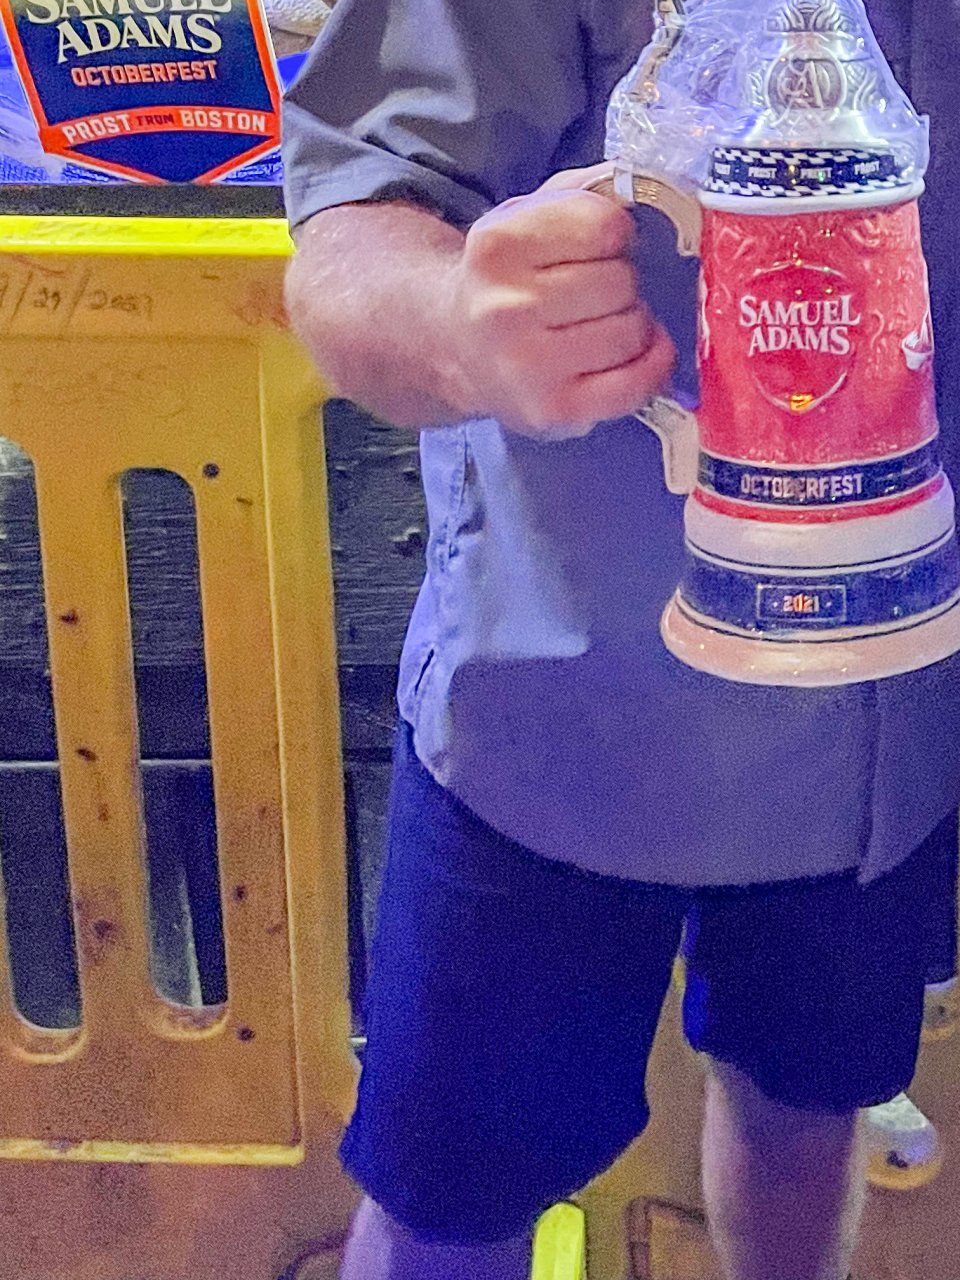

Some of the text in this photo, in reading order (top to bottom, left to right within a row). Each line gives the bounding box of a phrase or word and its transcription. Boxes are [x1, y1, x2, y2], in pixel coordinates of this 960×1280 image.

[57, 13, 223, 63] ADAMS
[71, 60, 217, 87] OCTOBERFEST
[61, 109, 265, 145] PROST FROM BOSTON
[739, 294, 861, 327] SAMUEL
[748, 326, 850, 357] ADAMS
